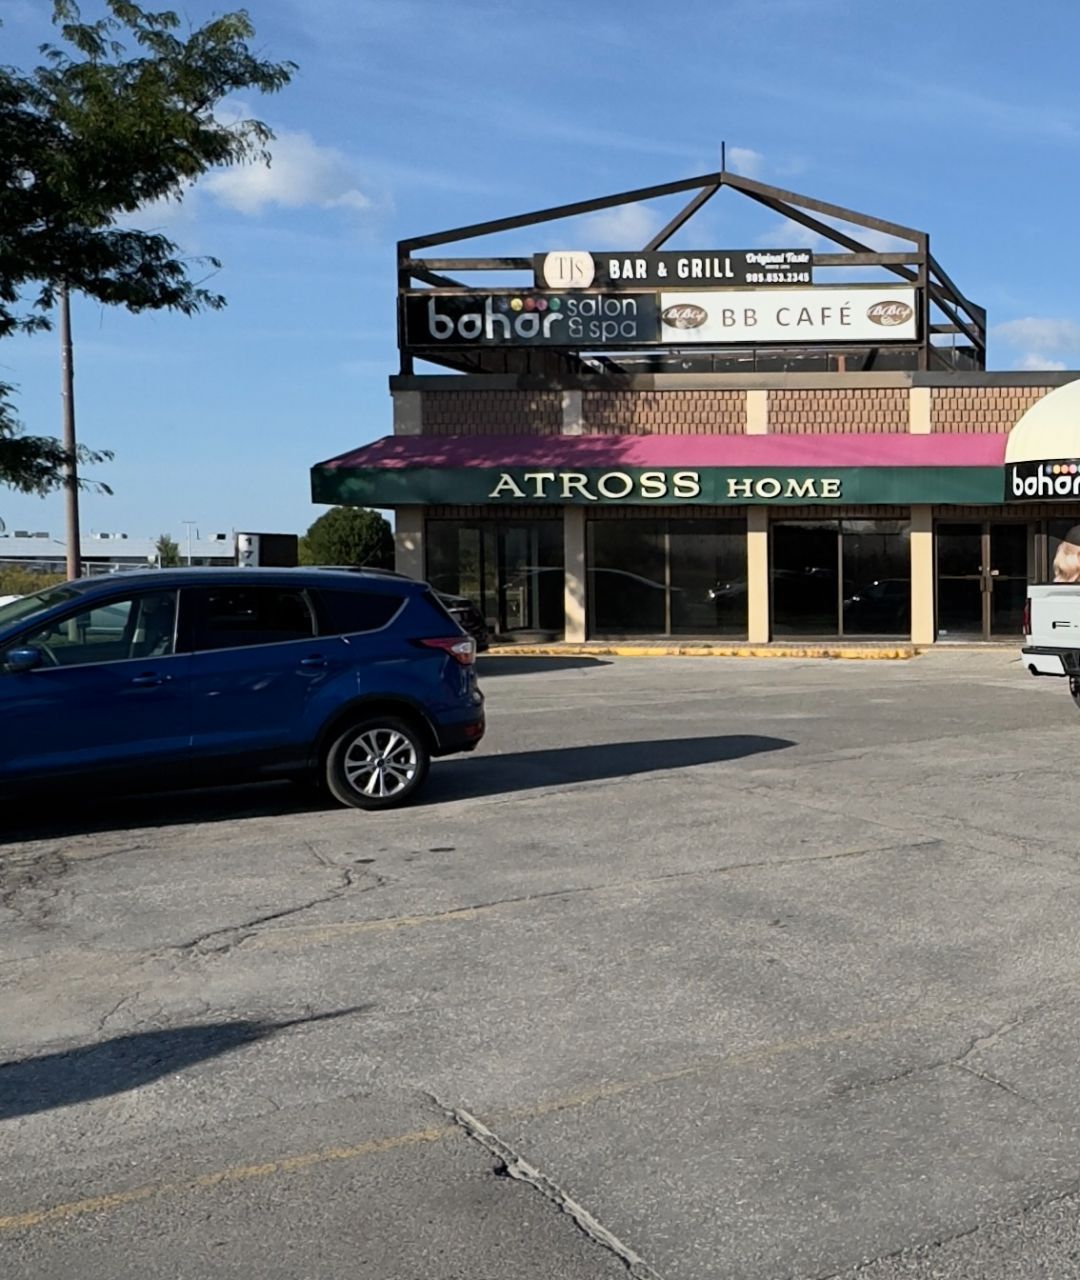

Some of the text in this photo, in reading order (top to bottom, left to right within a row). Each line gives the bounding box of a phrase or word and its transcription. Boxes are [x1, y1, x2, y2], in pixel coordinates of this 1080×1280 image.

[609, 258, 735, 279] BAR & GRILL
[566, 295, 637, 317] salon
[721, 300, 852, 328] BB CAFÉ
[568, 317, 637, 342] & spa
[488, 471, 842, 500] ATROSS HOME
